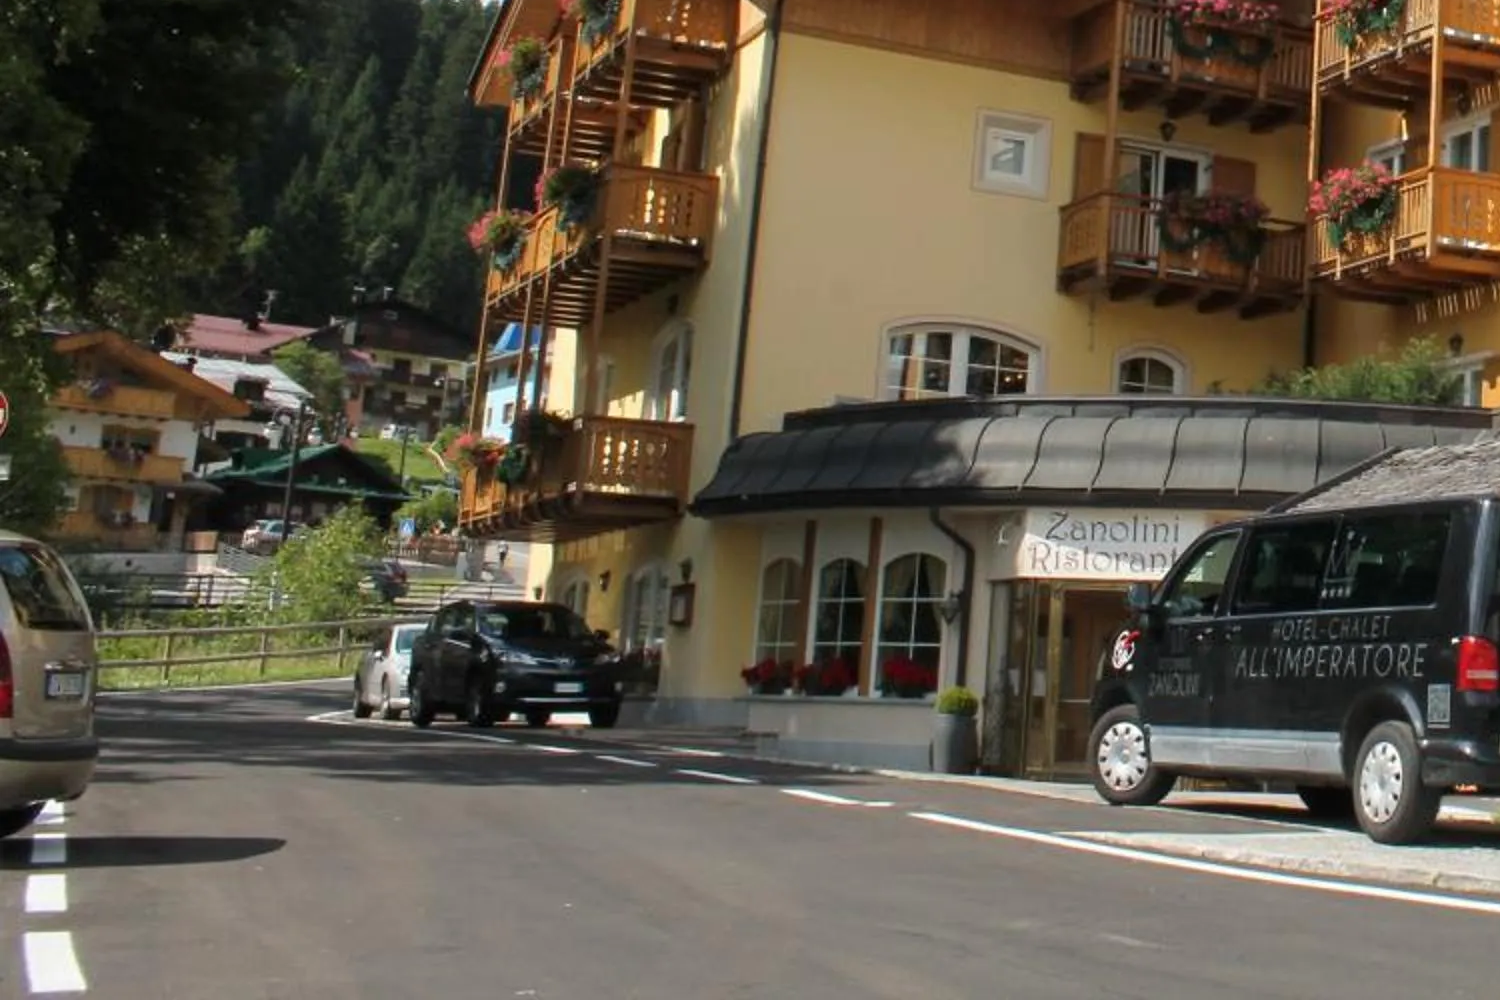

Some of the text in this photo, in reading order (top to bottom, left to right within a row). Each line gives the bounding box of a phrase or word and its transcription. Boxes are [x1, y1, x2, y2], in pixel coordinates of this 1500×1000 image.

[1045, 511, 1180, 543] Zanolini
[1028, 541, 1181, 573] Ristorant
[1272, 616, 1391, 641] HOTEL-CHALET
[1235, 644, 1428, 679] ALL'IMPERATORE
